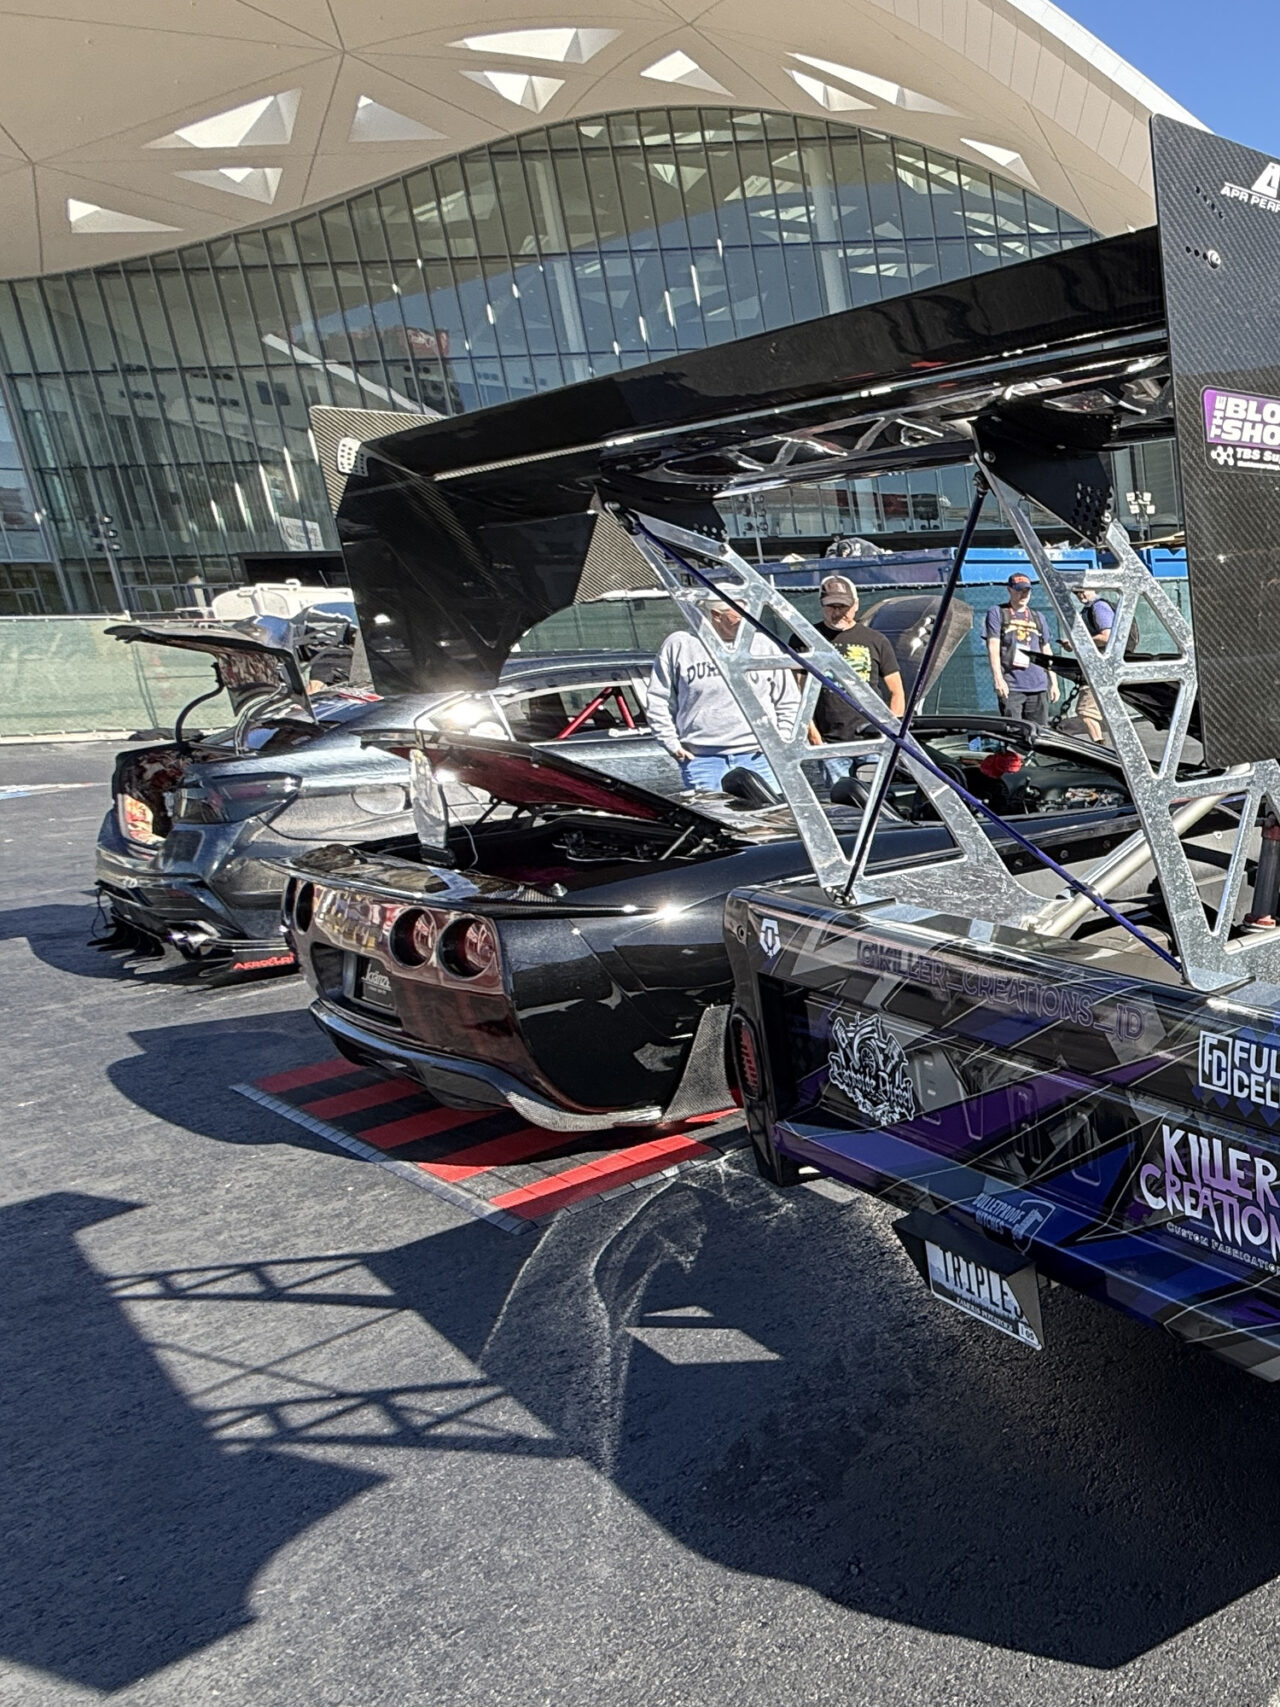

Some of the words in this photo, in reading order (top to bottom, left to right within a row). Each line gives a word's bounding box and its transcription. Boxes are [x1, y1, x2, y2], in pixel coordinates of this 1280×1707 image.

[1220, 185, 1249, 203] APR
[1210, 396, 1227, 438] THE
[1235, 447, 1261, 460] TBS
[1162, 1124, 1280, 1212] KILLER
[972, 1192, 1025, 1224] BULLETPROOF
[1166, 1221, 1209, 1247] CUSTOM
